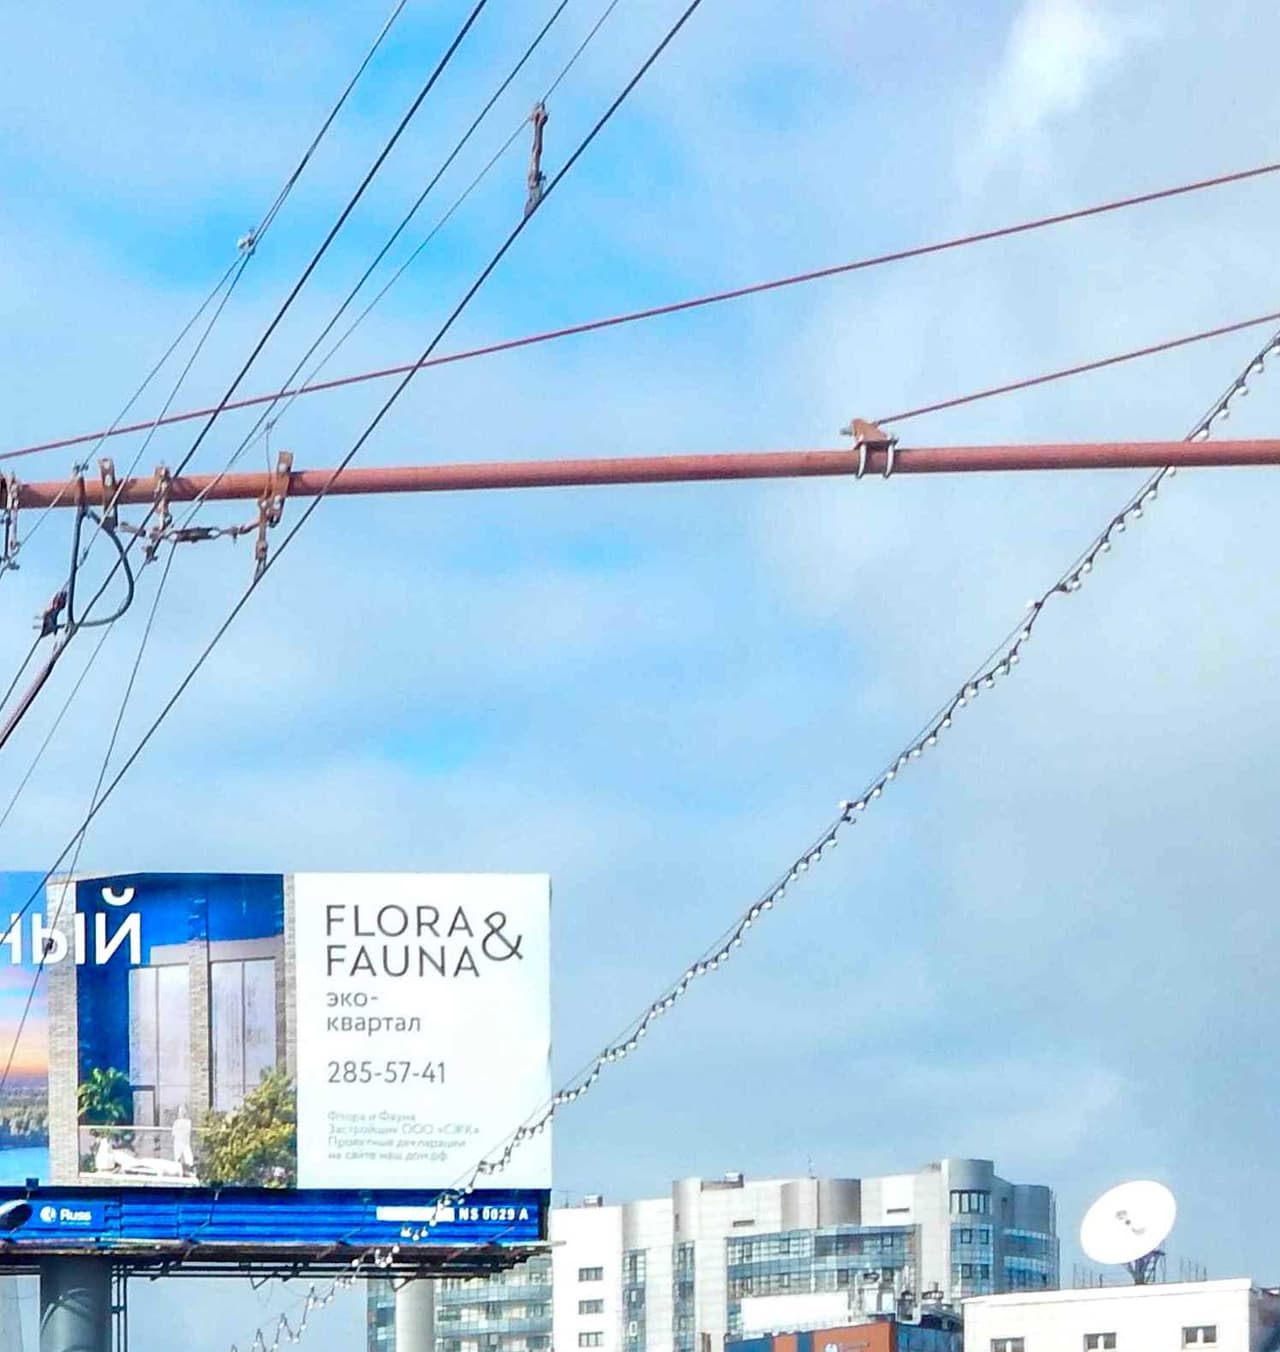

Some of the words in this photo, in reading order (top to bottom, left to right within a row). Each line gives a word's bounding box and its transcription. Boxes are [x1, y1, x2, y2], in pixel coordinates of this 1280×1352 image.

[326, 904, 474, 938] FLORA
[481, 910, 523, 962] &
[326, 944, 481, 978] FAUNA
[326, 991, 379, 1008] эко-
[326, 1016, 421, 1037] квартал
[327, 1060, 445, 1084] 285-57-41
